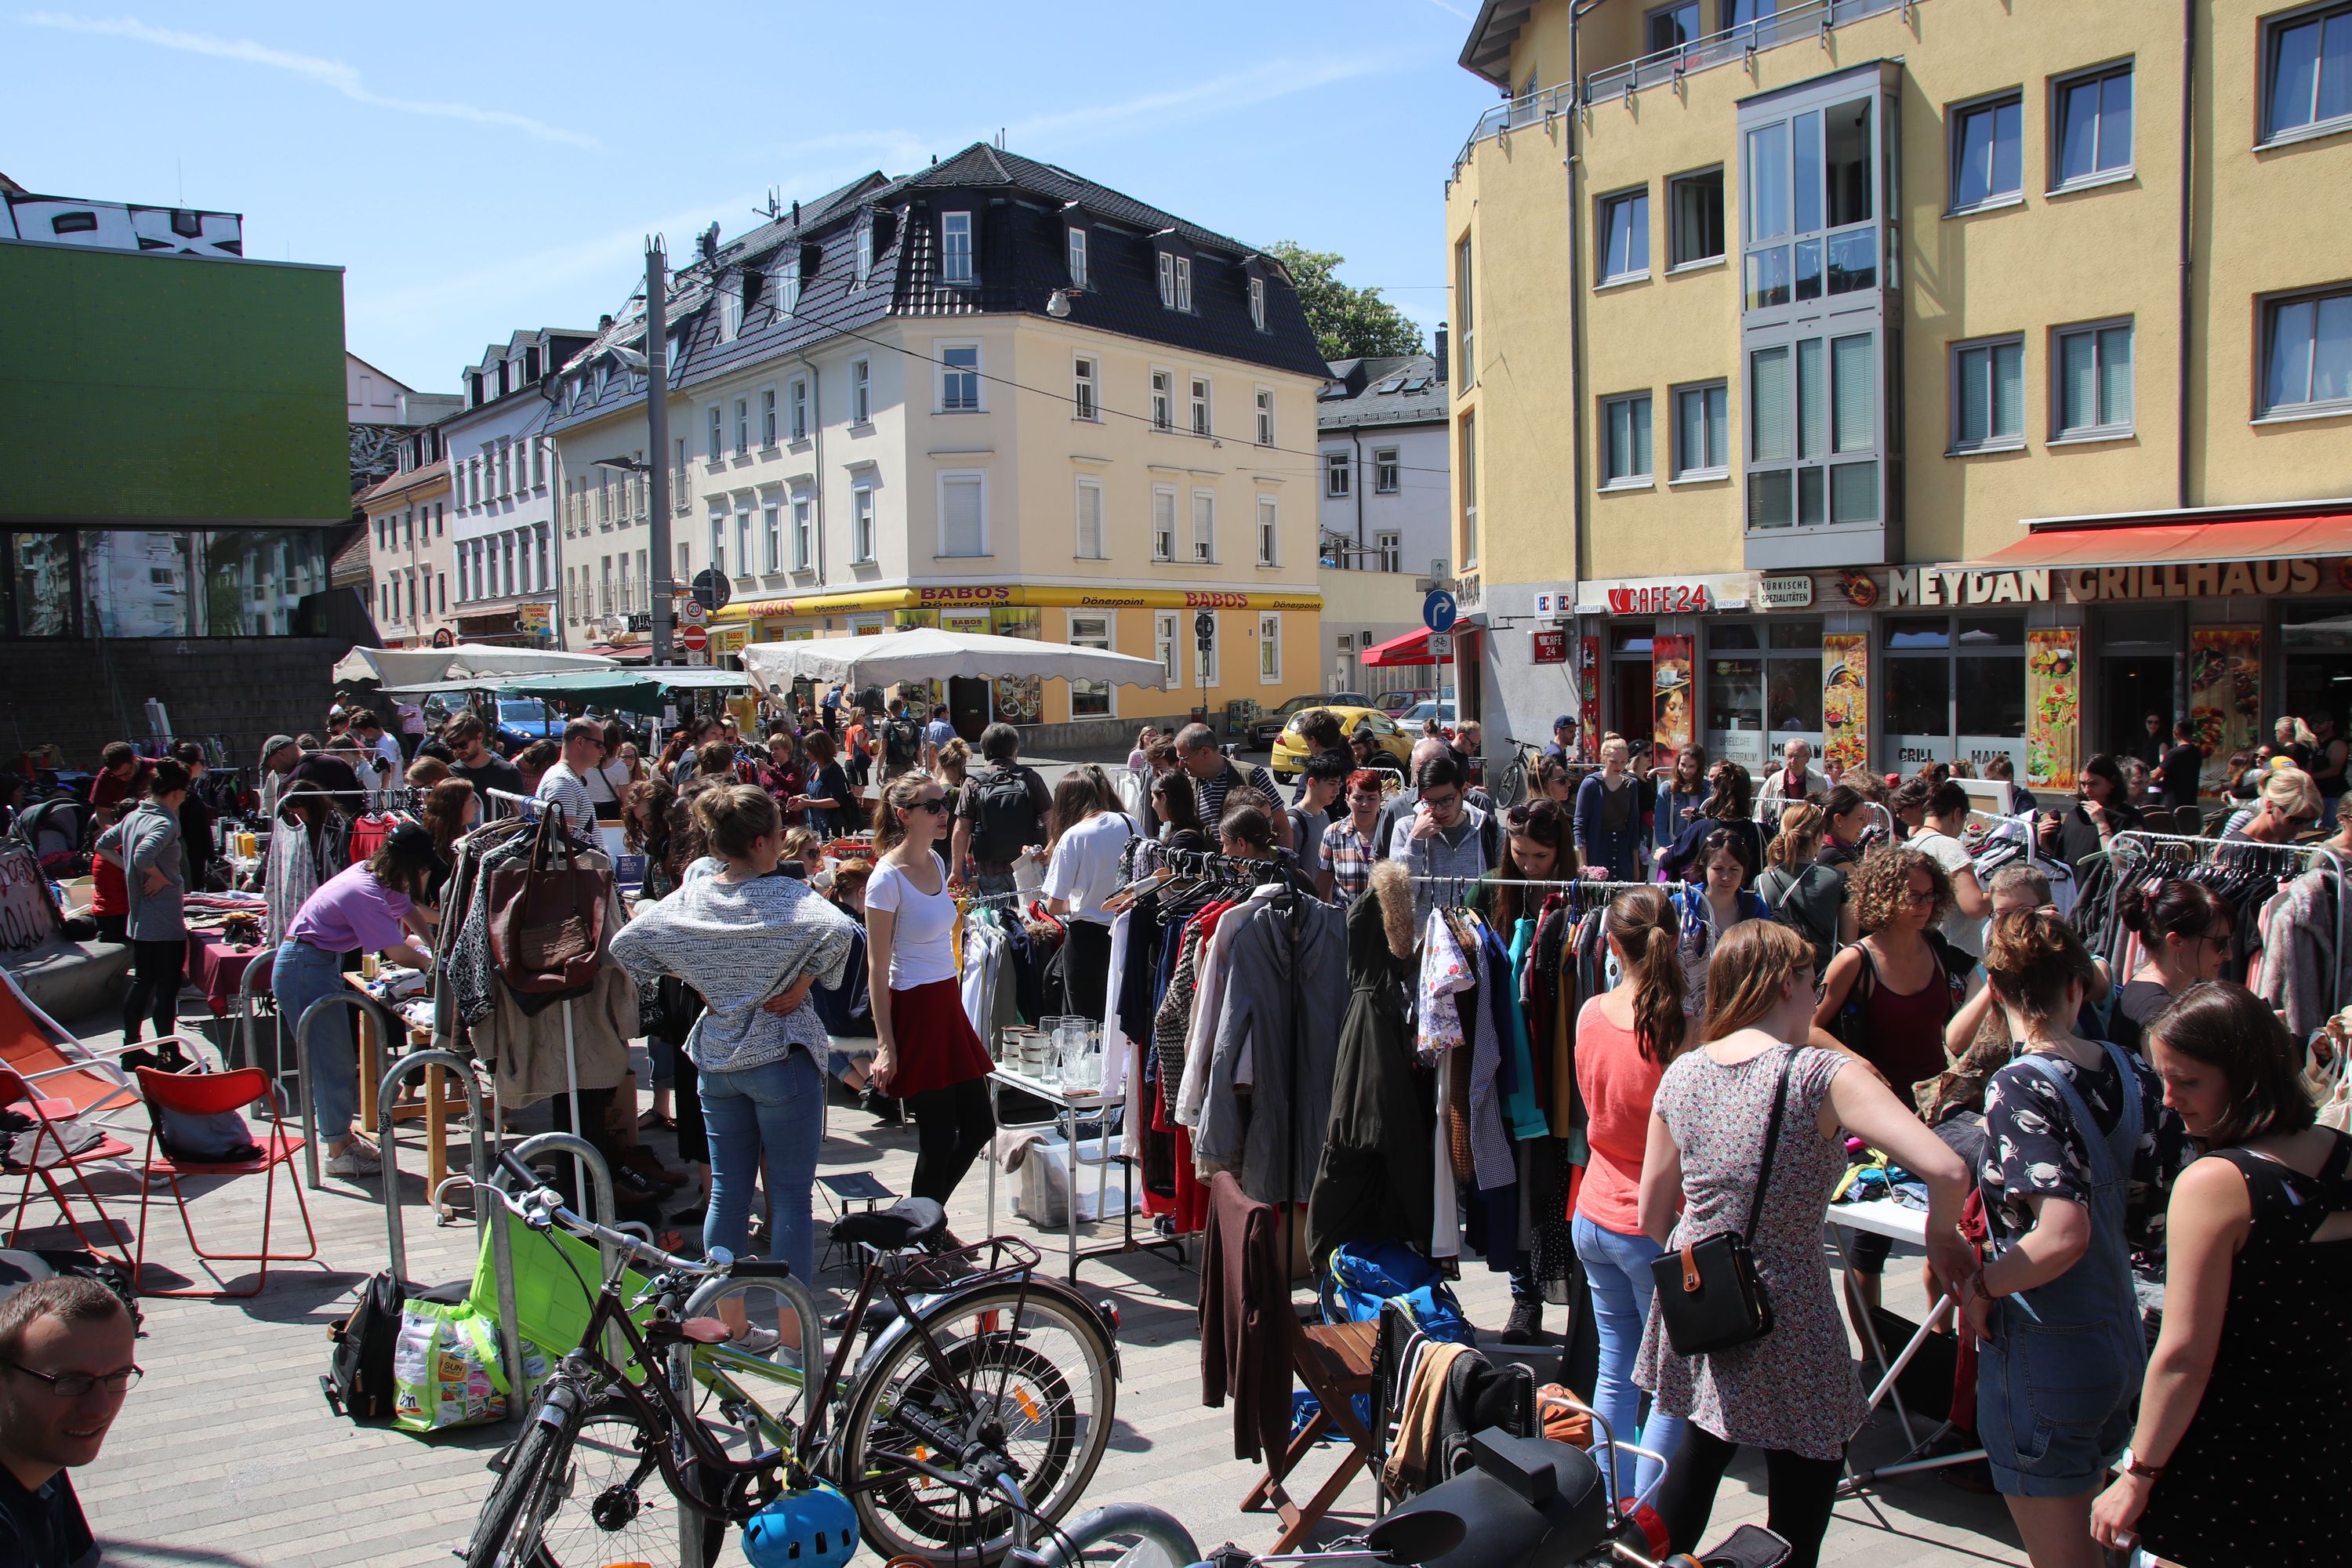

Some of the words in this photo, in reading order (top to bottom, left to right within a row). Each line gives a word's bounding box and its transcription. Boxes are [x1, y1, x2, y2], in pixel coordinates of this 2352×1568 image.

[1762, 580, 1808, 590] TÜRKISCHE
[1889, 567, 2051, 606] MEYDAN
[2070, 557, 2319, 602] GRILLHAUS
[920, 586, 1010, 599] BABOS
[1762, 592, 1808, 603] SPEZIALITÄTEN
[1082, 597, 1145, 606] Dönerpoint
[1185, 592, 1248, 608] BABOS
[1628, 586, 1672, 614] CAFE
[1676, 584, 1707, 612] 24
[748, 601, 794, 618] BABOS
[815, 603, 862, 613] Dönerpoint
[1273, 601, 1321, 610] Dönerpoint
[1546, 635, 1563, 645] CAFE
[1545, 647, 1556, 656] 24
[1719, 737, 1751, 746] SPIELCAFE
[1899, 748, 1934, 762] GRILL
[445, 1362, 463, 1371] SUN
